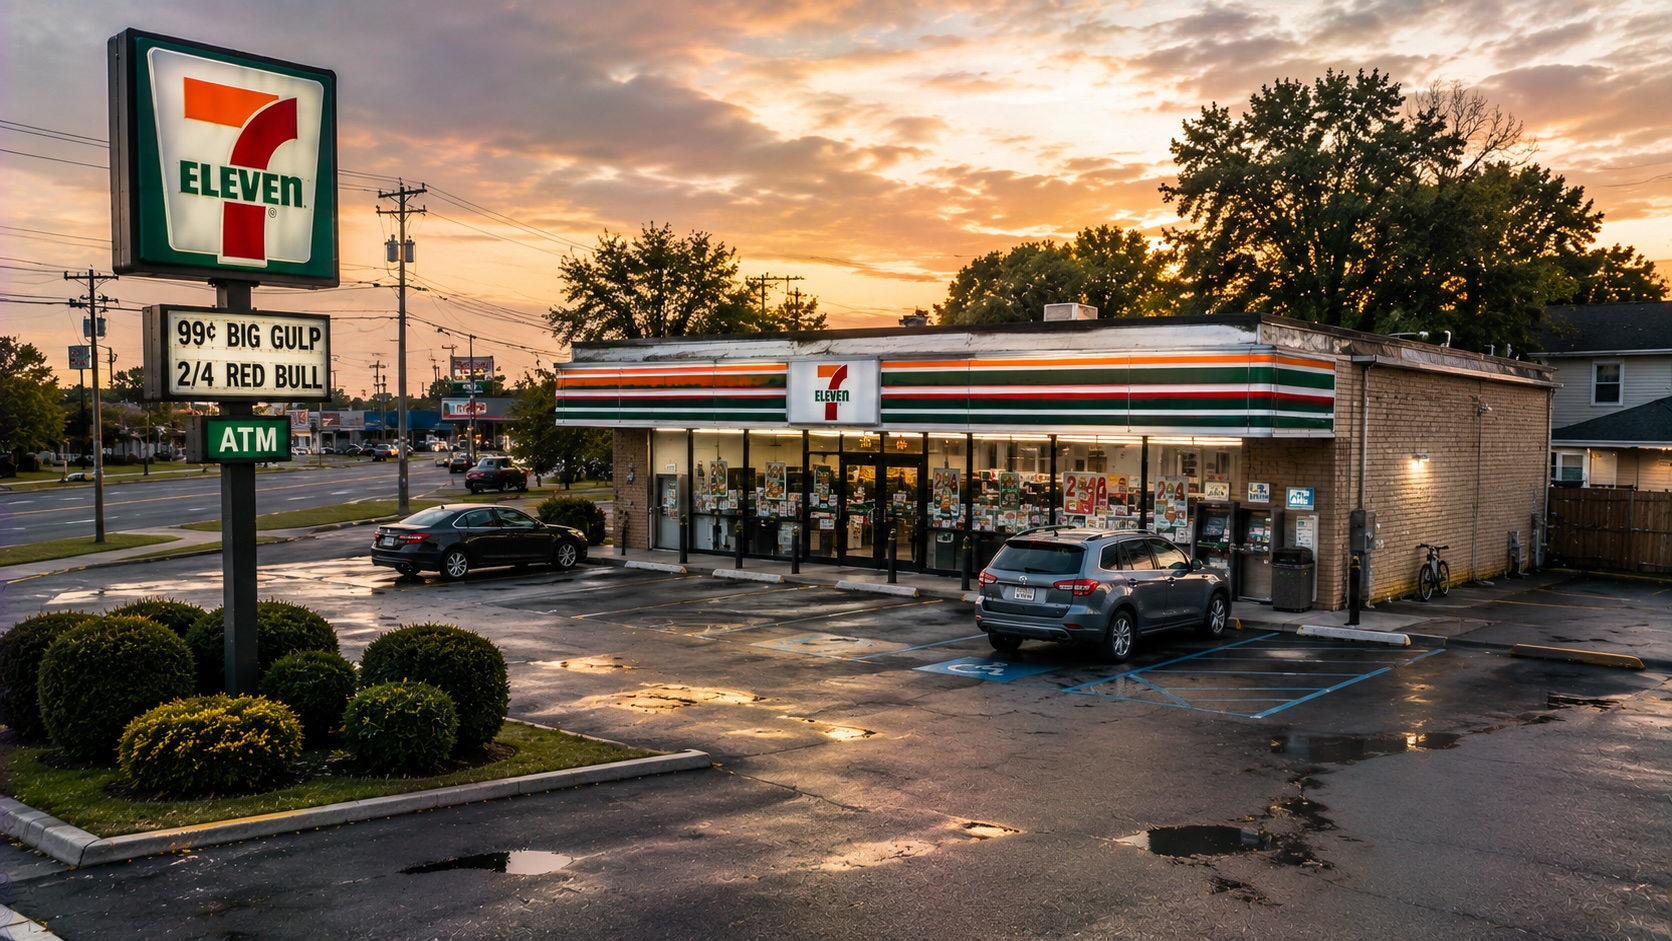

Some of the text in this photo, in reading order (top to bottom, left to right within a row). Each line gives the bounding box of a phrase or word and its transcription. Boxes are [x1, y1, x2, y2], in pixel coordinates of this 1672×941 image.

[184, 77, 298, 260] 7
[177, 320, 321, 350] 99¢ BIG GULP
[177, 361, 323, 389] 2/4 RED BULL
[817, 364, 848, 420] 7
[219, 427, 277, 453] ATM
